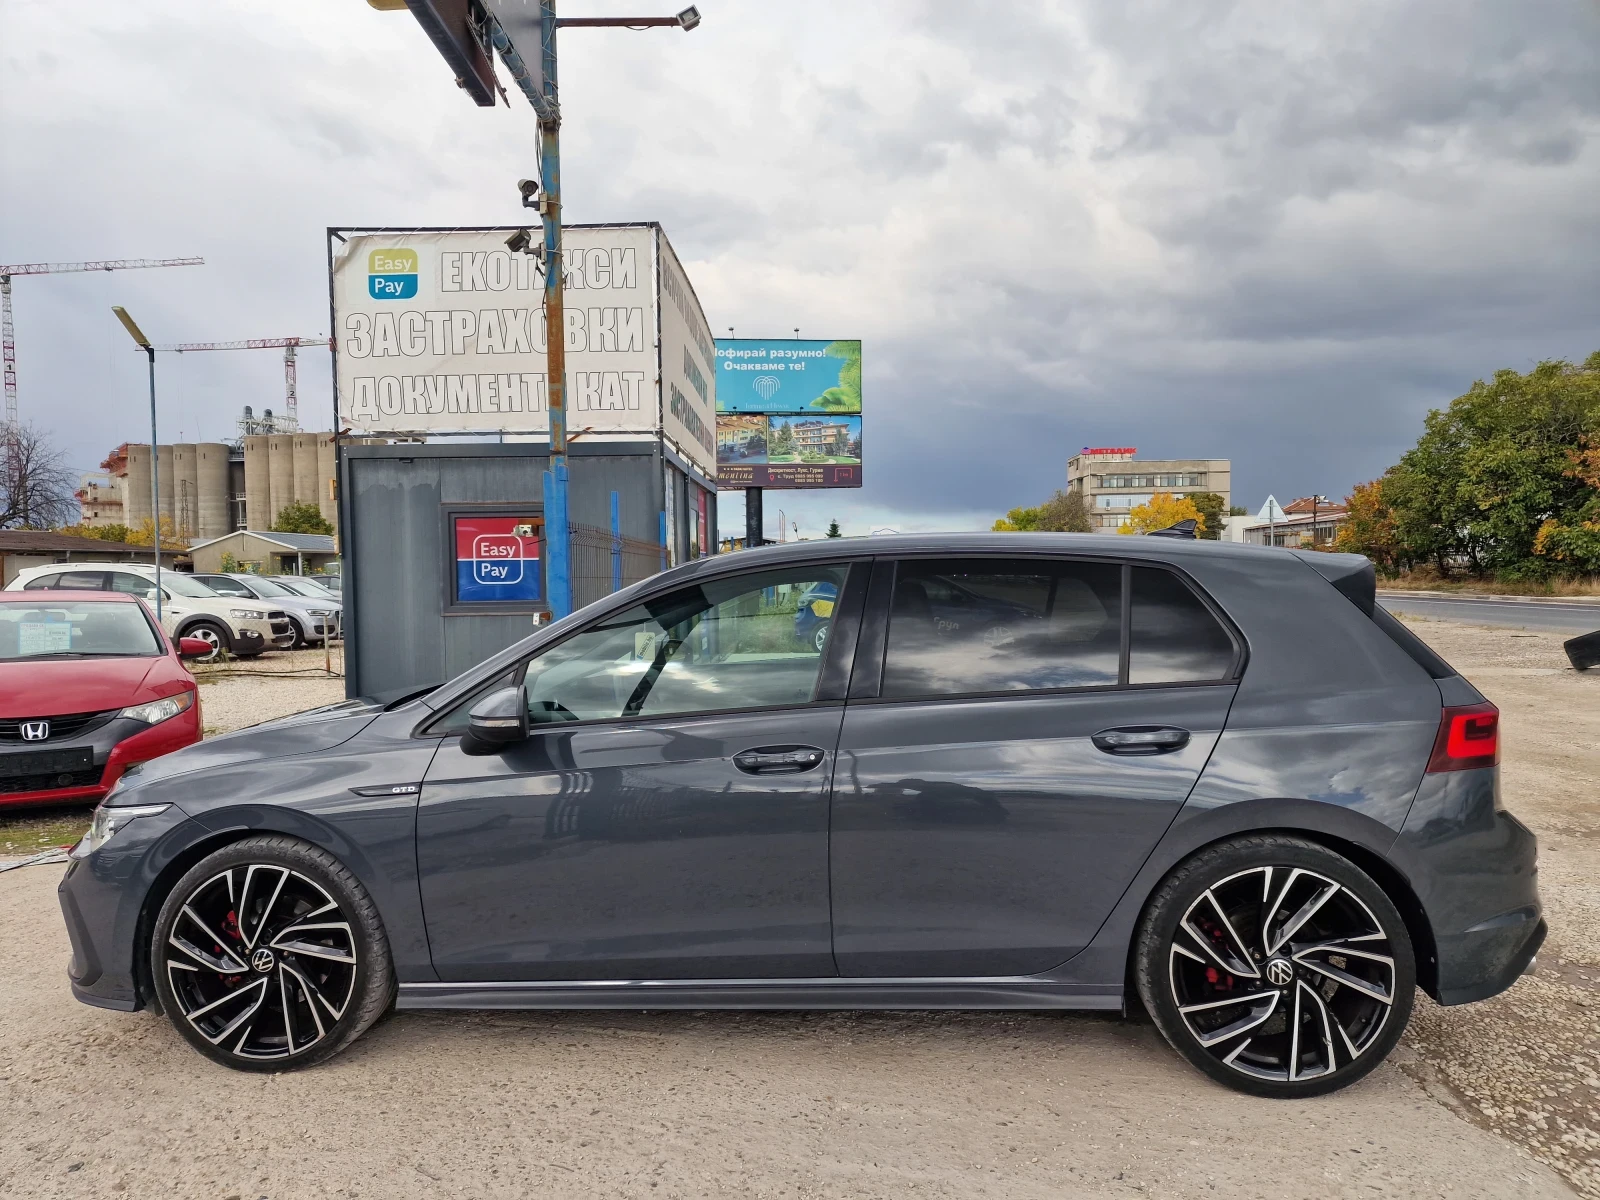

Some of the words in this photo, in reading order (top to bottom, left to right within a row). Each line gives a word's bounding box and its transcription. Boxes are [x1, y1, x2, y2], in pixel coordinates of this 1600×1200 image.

[375, 255, 413, 272] Easy
[375, 278, 404, 296] Pay
[346, 307, 644, 358] ЗАСТРАХОВКИ
[770, 348, 826, 360] разумно!
[724, 361, 785, 371] Очакваме
[789, 361, 805, 371] те!
[351, 372, 568, 421] ДОКУМЕНТ
[576, 371, 644, 411] КАТ
[480, 542, 516, 558] Easy
[481, 563, 508, 578] Pay
